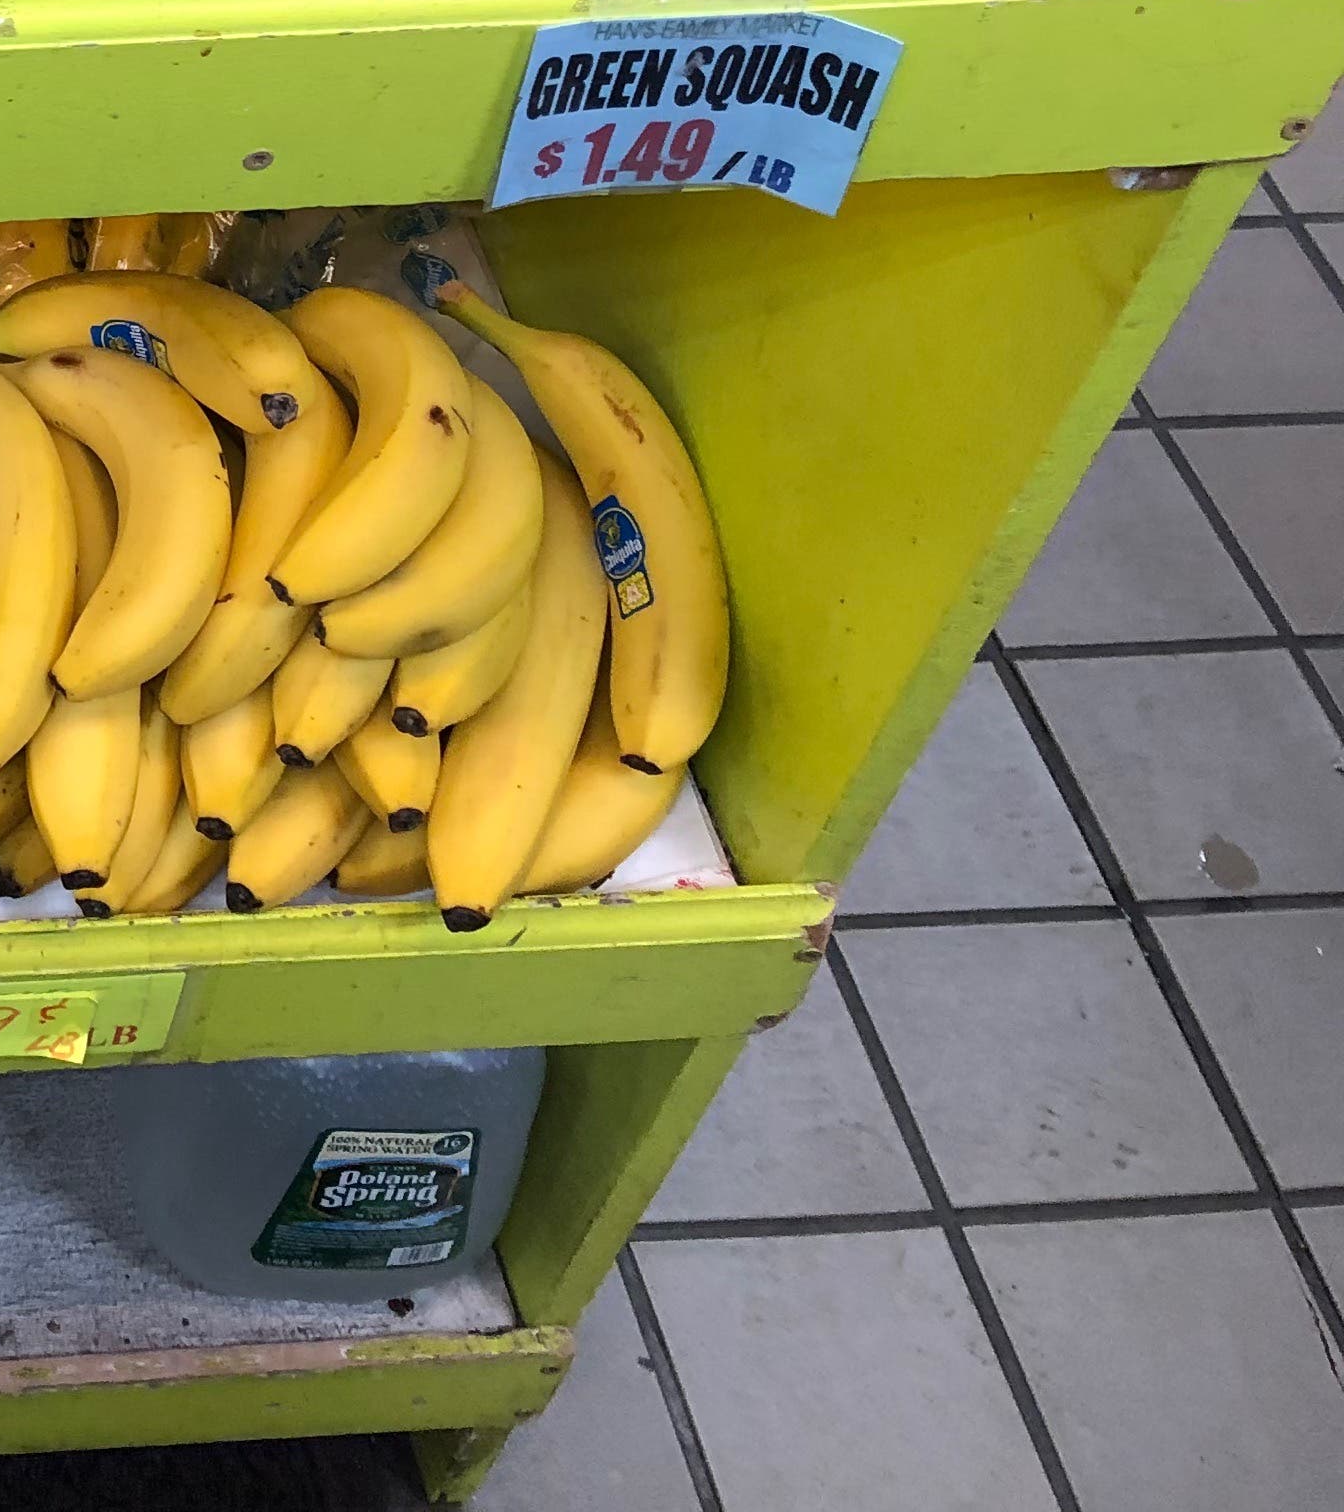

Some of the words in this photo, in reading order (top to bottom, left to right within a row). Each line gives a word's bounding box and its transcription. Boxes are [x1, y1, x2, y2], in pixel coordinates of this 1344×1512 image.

[526, 48, 677, 121] GREEN
[673, 44, 880, 131] SQUASH
[364, 1137, 433, 1146] NATURAL
[380, 1145, 431, 1155] WATER
[338, 1170, 436, 1188] Poland
[319, 1184, 439, 1208] Spring
